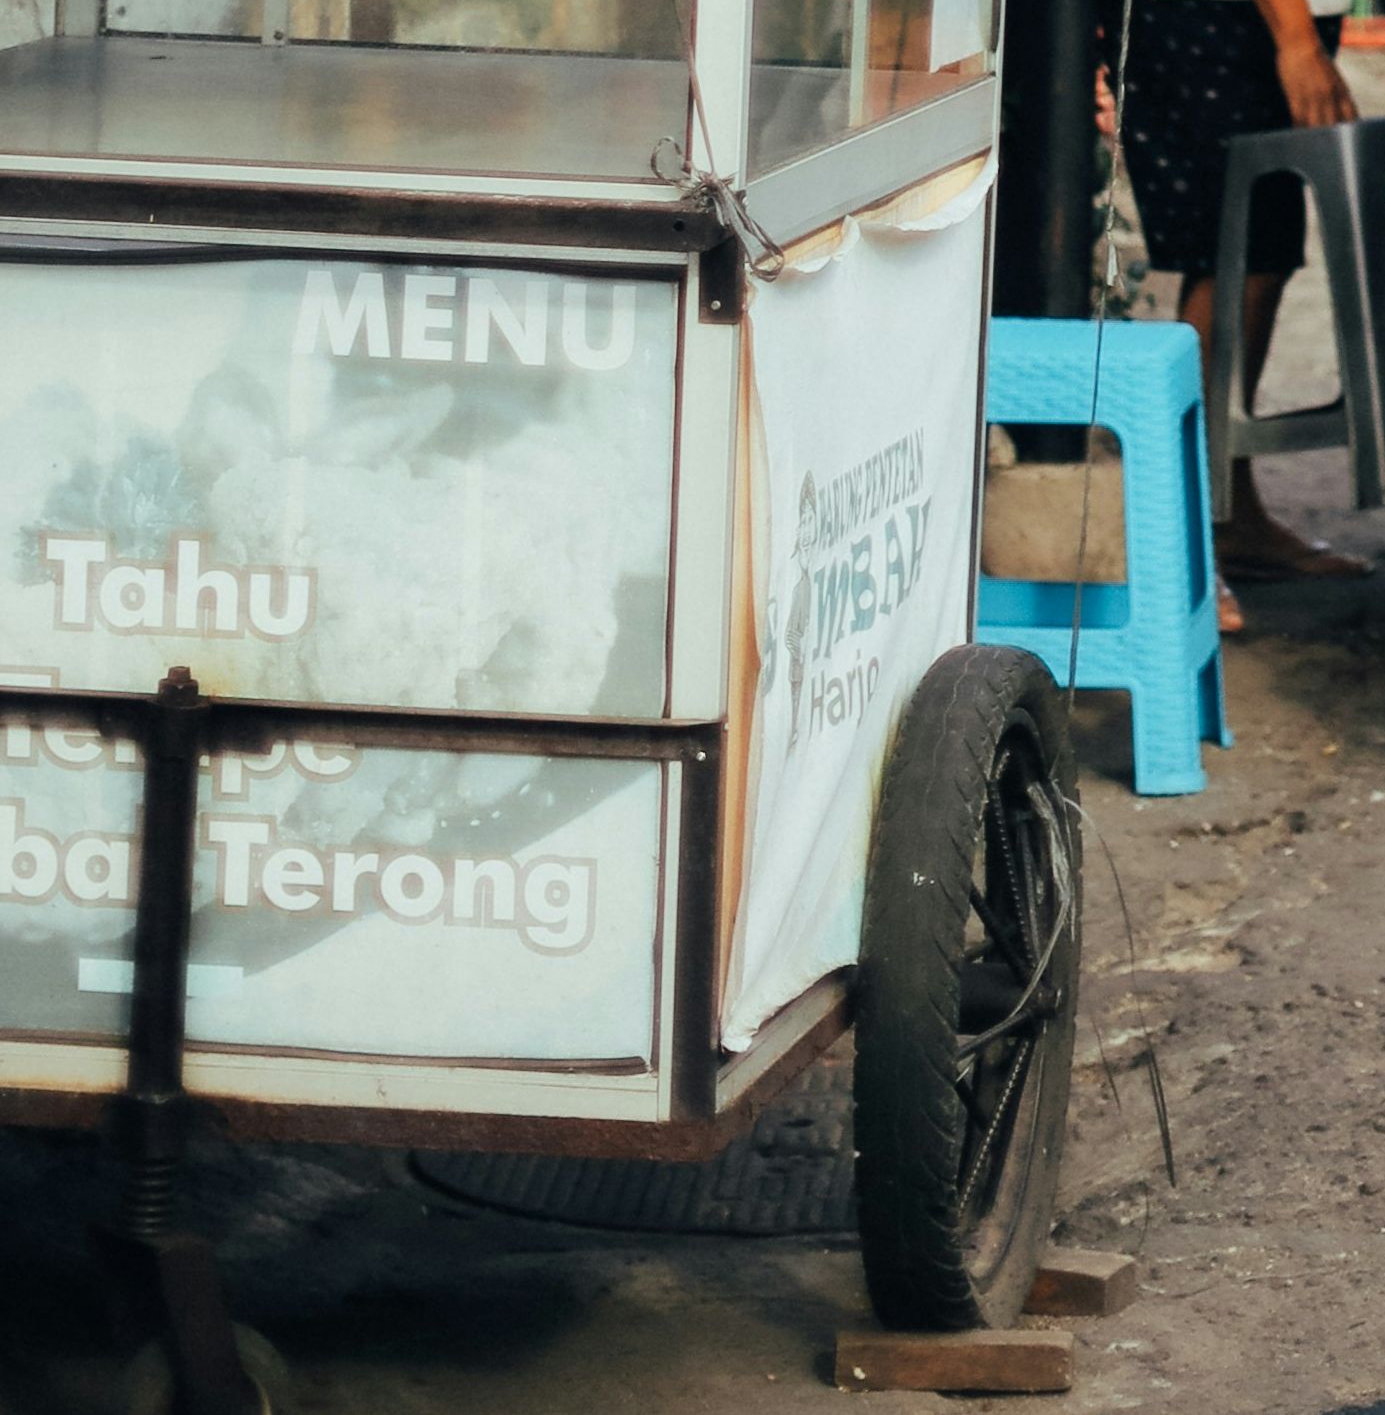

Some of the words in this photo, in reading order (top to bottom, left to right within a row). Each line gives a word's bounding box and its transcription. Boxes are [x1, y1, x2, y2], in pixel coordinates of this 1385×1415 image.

[292, 270, 637, 371] MENU
[44, 537, 312, 637] Tahu
[812, 494, 931, 662] MBAH
[808, 648, 880, 738] Harjo
[206, 819, 592, 950] Terong
